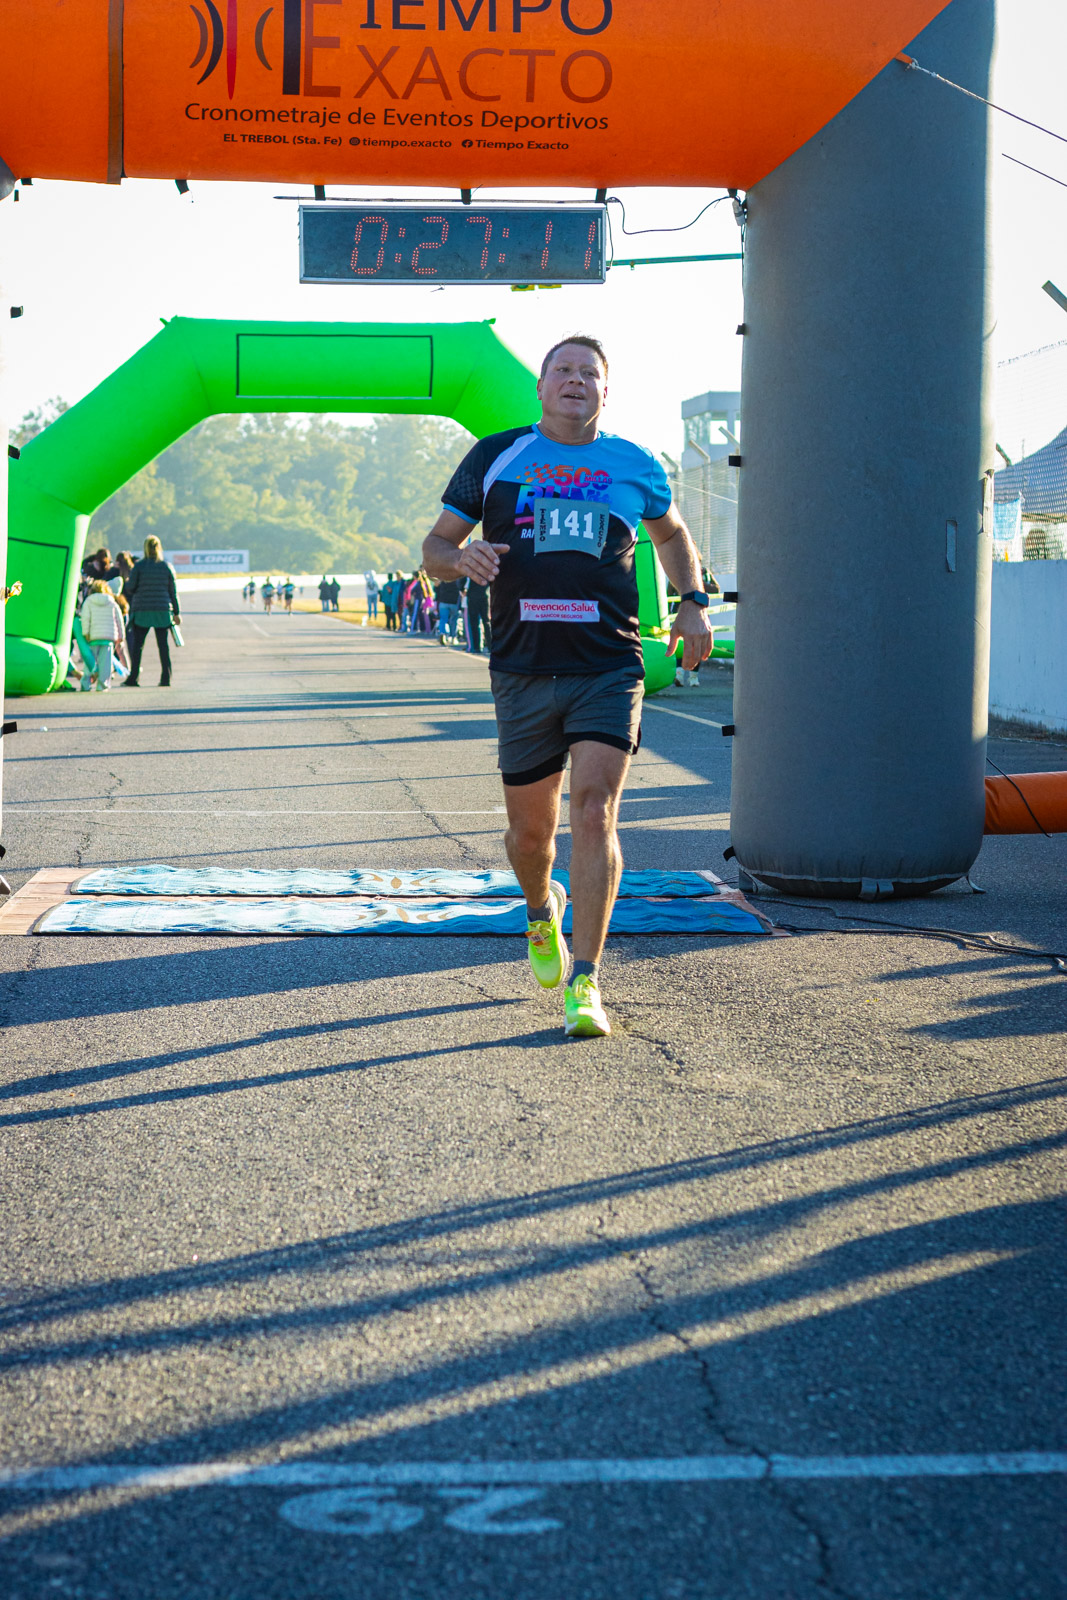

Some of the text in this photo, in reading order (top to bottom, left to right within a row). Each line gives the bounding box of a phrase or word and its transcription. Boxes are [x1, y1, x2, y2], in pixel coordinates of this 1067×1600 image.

[303, 0, 613, 104] EXACTO
[184, 102, 609, 132] Cronometraje de Eventos Deportivos
[223, 133, 570, 151] EL TREBOL (Sta. Fe) tiempo.exacto Tiempo Exacto
[549, 508, 594, 540] 141
[194, 554, 240, 563] LONG
[571, 602, 596, 613] Salud
